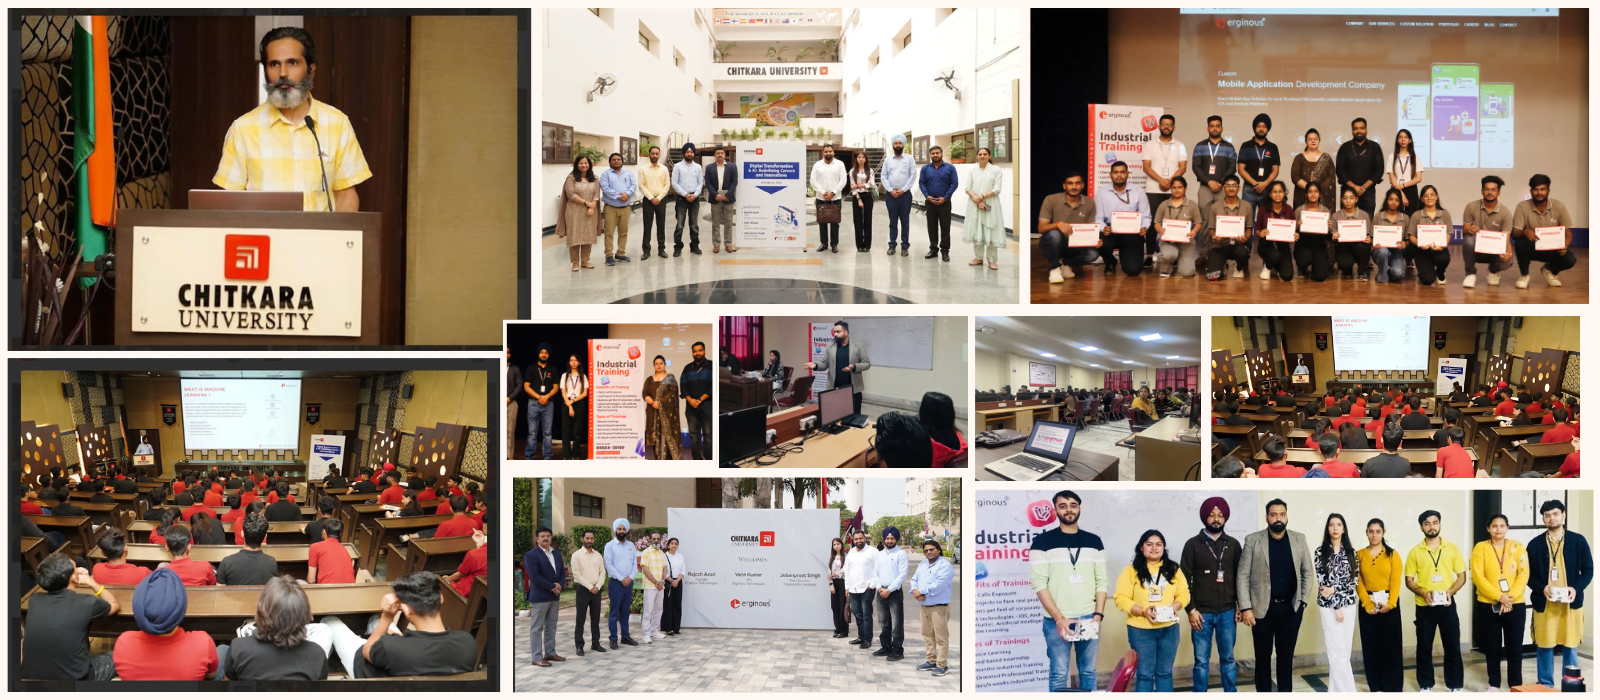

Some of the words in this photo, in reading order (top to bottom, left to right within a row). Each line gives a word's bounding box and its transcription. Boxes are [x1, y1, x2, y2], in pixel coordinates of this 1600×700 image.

[727, 66, 767, 76] CHITKARA
[769, 66, 818, 76] UNIVERSITY
[1217, 80, 1245, 88] Mobile
[1246, 80, 1293, 89] Application
[1295, 80, 1346, 90] Development
[1348, 81, 1385, 90] Company
[1100, 132, 1152, 142] Industrial
[1098, 142, 1143, 153] Training
[178, 283, 315, 311] CHITKARA
[178, 309, 315, 331] UNIVERSITY
[596, 360, 637, 368] Industrial
[596, 367, 630, 378] Training
[741, 600, 771, 608] erginous
[979, 614, 1014, 622] technologies
[996, 619, 1019, 627] Artificial
[995, 637, 1030, 647] Trainings
[1001, 670, 1034, 679] Professional
